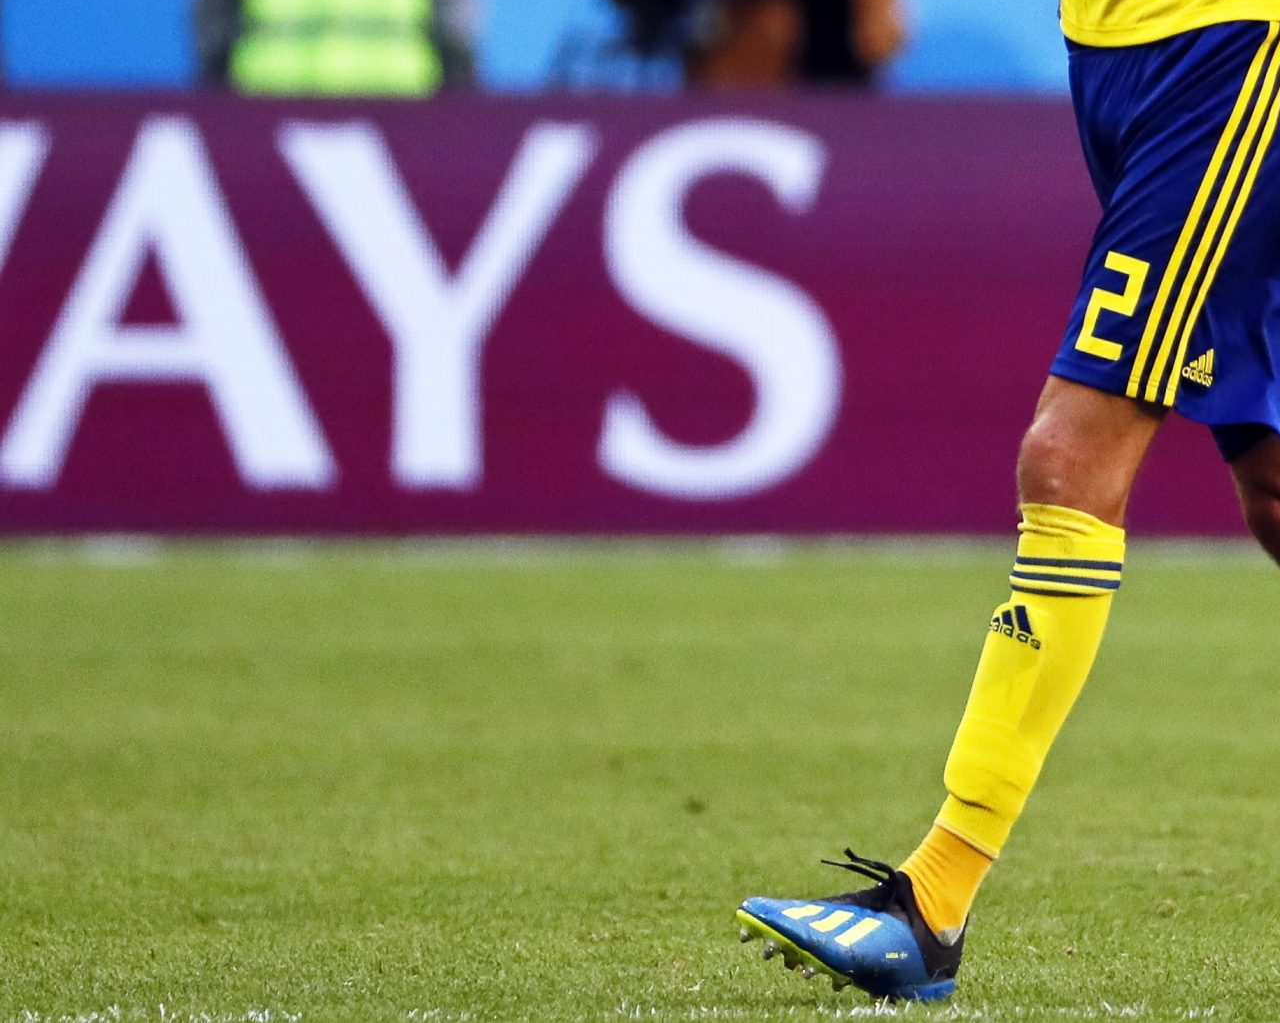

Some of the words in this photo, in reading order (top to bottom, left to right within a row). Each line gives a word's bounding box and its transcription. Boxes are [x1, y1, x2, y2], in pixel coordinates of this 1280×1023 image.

[0, 114, 846, 501] AYS
[1074, 250, 1151, 362] 2
[1181, 365, 1214, 388] adidas
